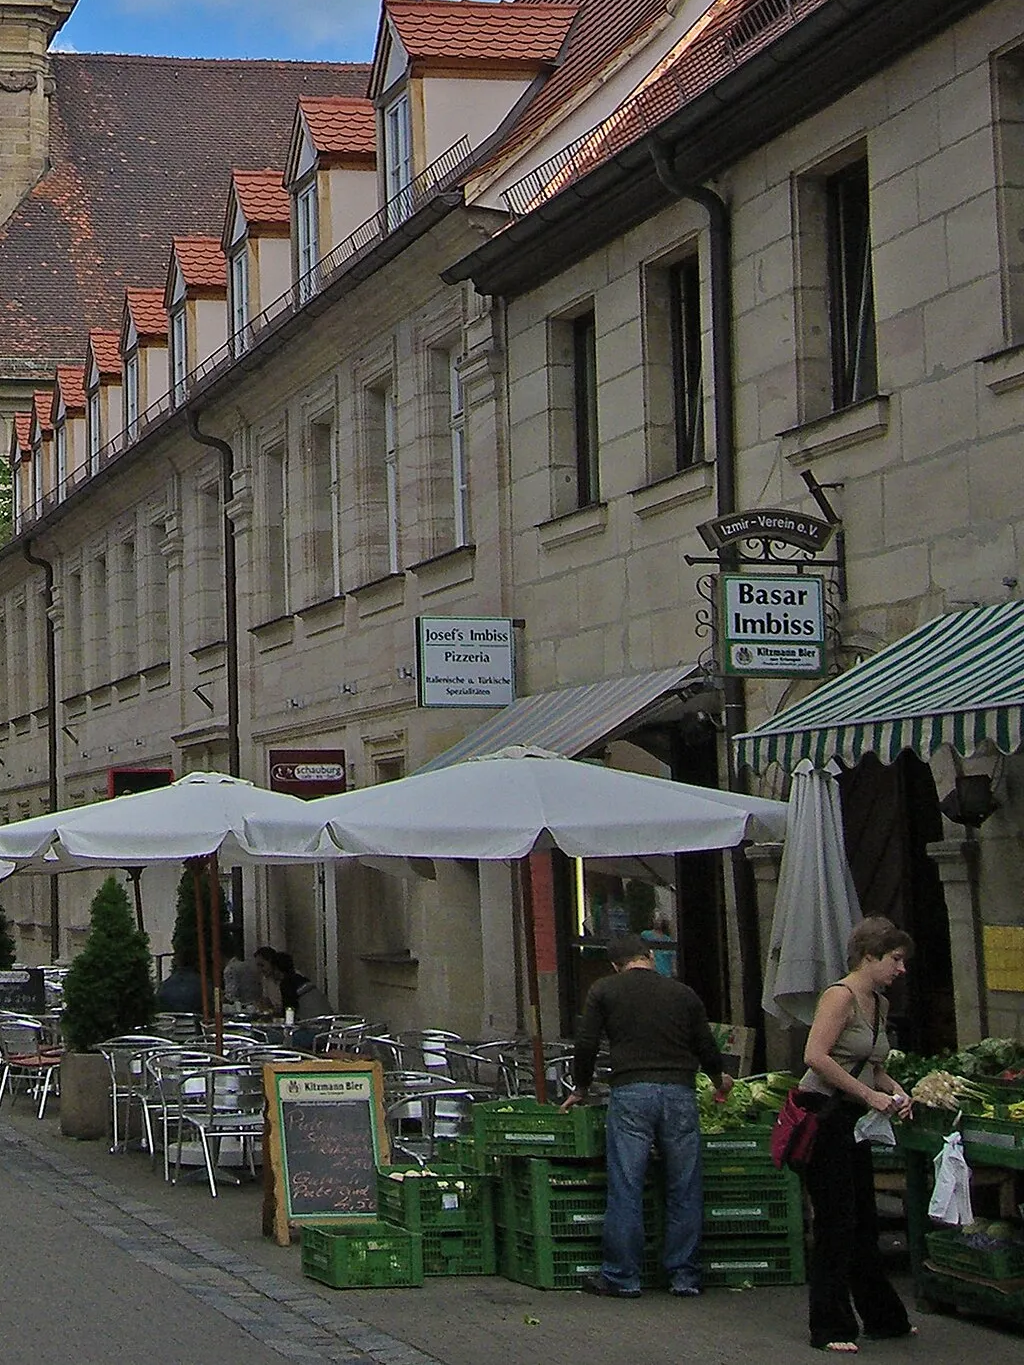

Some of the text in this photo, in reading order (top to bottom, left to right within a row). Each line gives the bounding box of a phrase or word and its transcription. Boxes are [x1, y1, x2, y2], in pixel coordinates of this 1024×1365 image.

[738, 583, 808, 605] Basar
[734, 612, 815, 635] Imbiss
[470, 629, 509, 642] Imbiss
[444, 651, 490, 663] Pizzeria
[757, 647, 816, 657] Kitzmann Bier
[296, 765, 341, 776] schauburg
[305, 1081, 364, 1091] Kitzmann Bier
